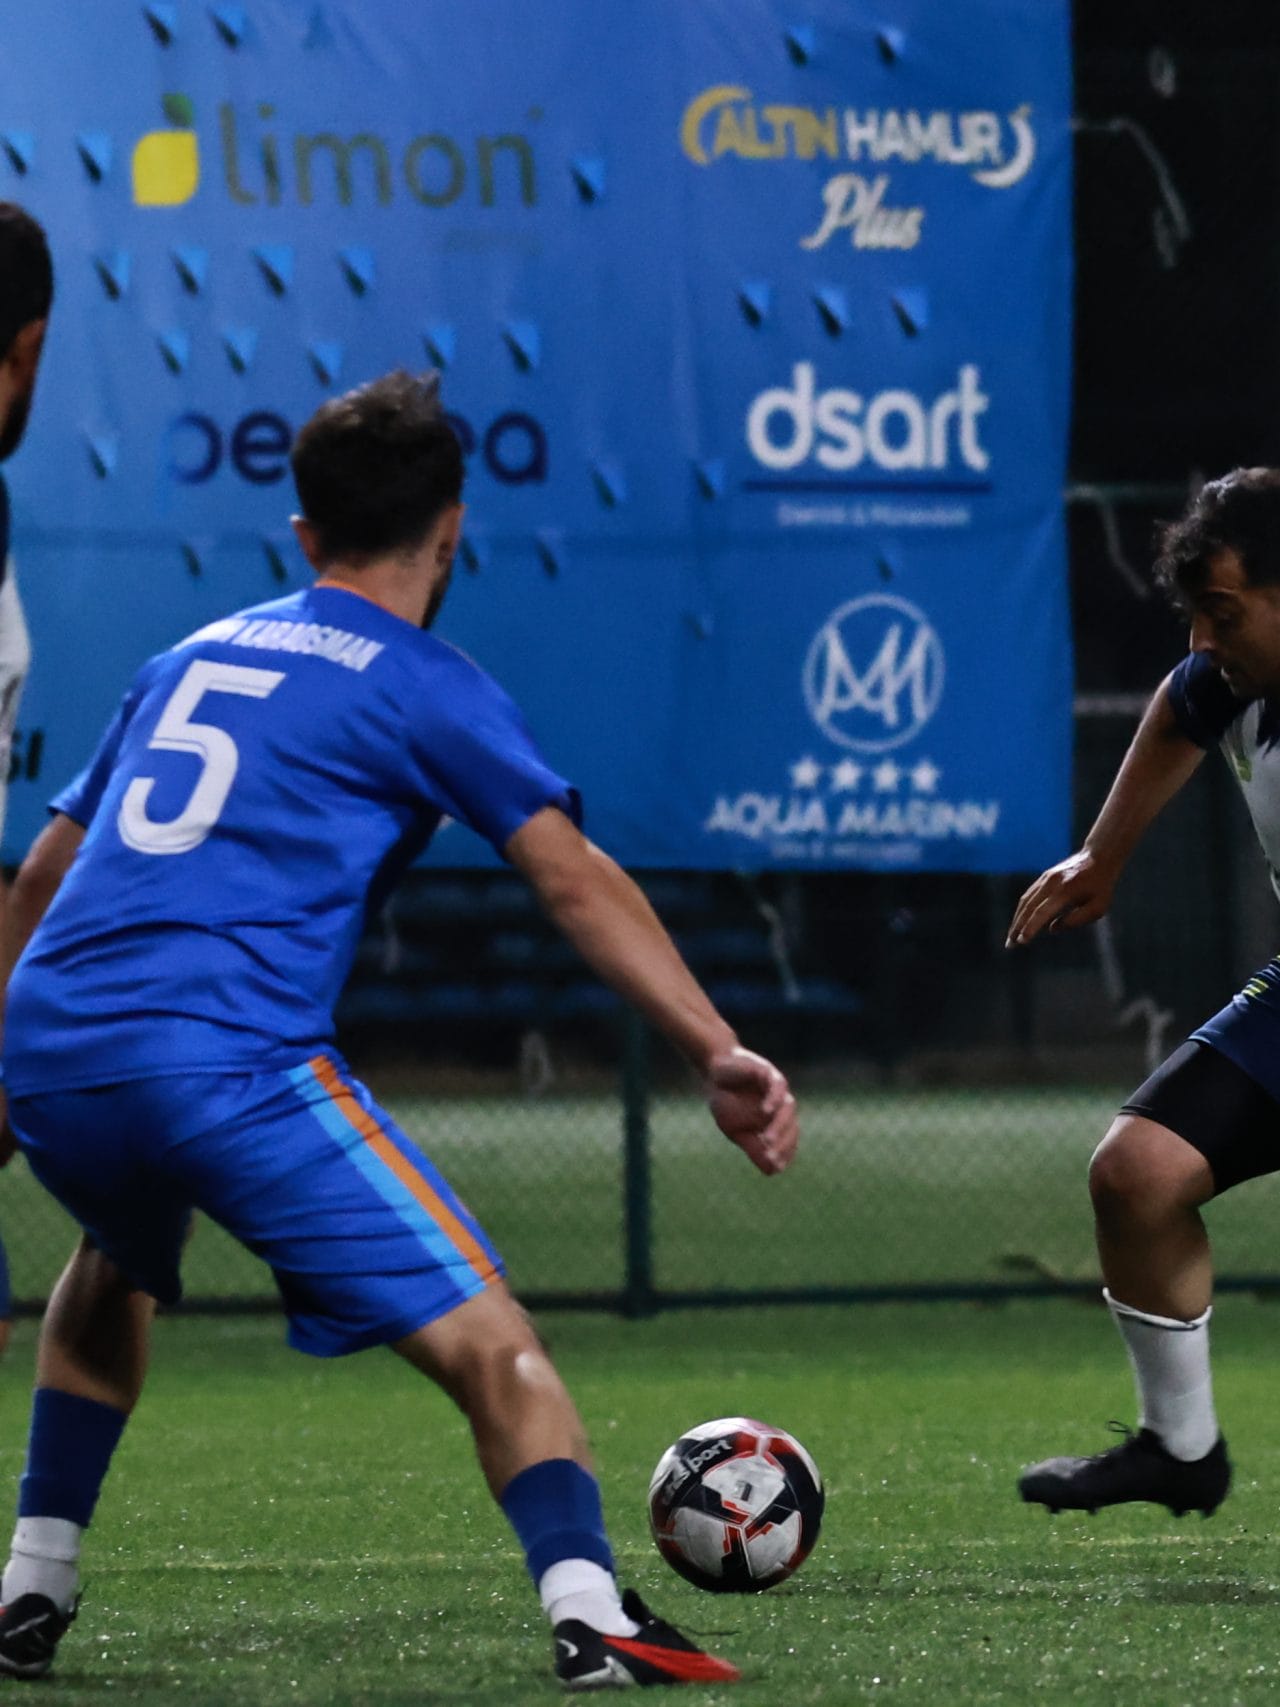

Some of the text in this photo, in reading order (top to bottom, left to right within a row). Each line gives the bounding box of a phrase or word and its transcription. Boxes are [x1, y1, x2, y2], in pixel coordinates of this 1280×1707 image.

[219, 103, 538, 206] limon
[800, 172, 925, 250] Plus
[747, 361, 990, 471] dsart
[117, 659, 286, 855] 5
